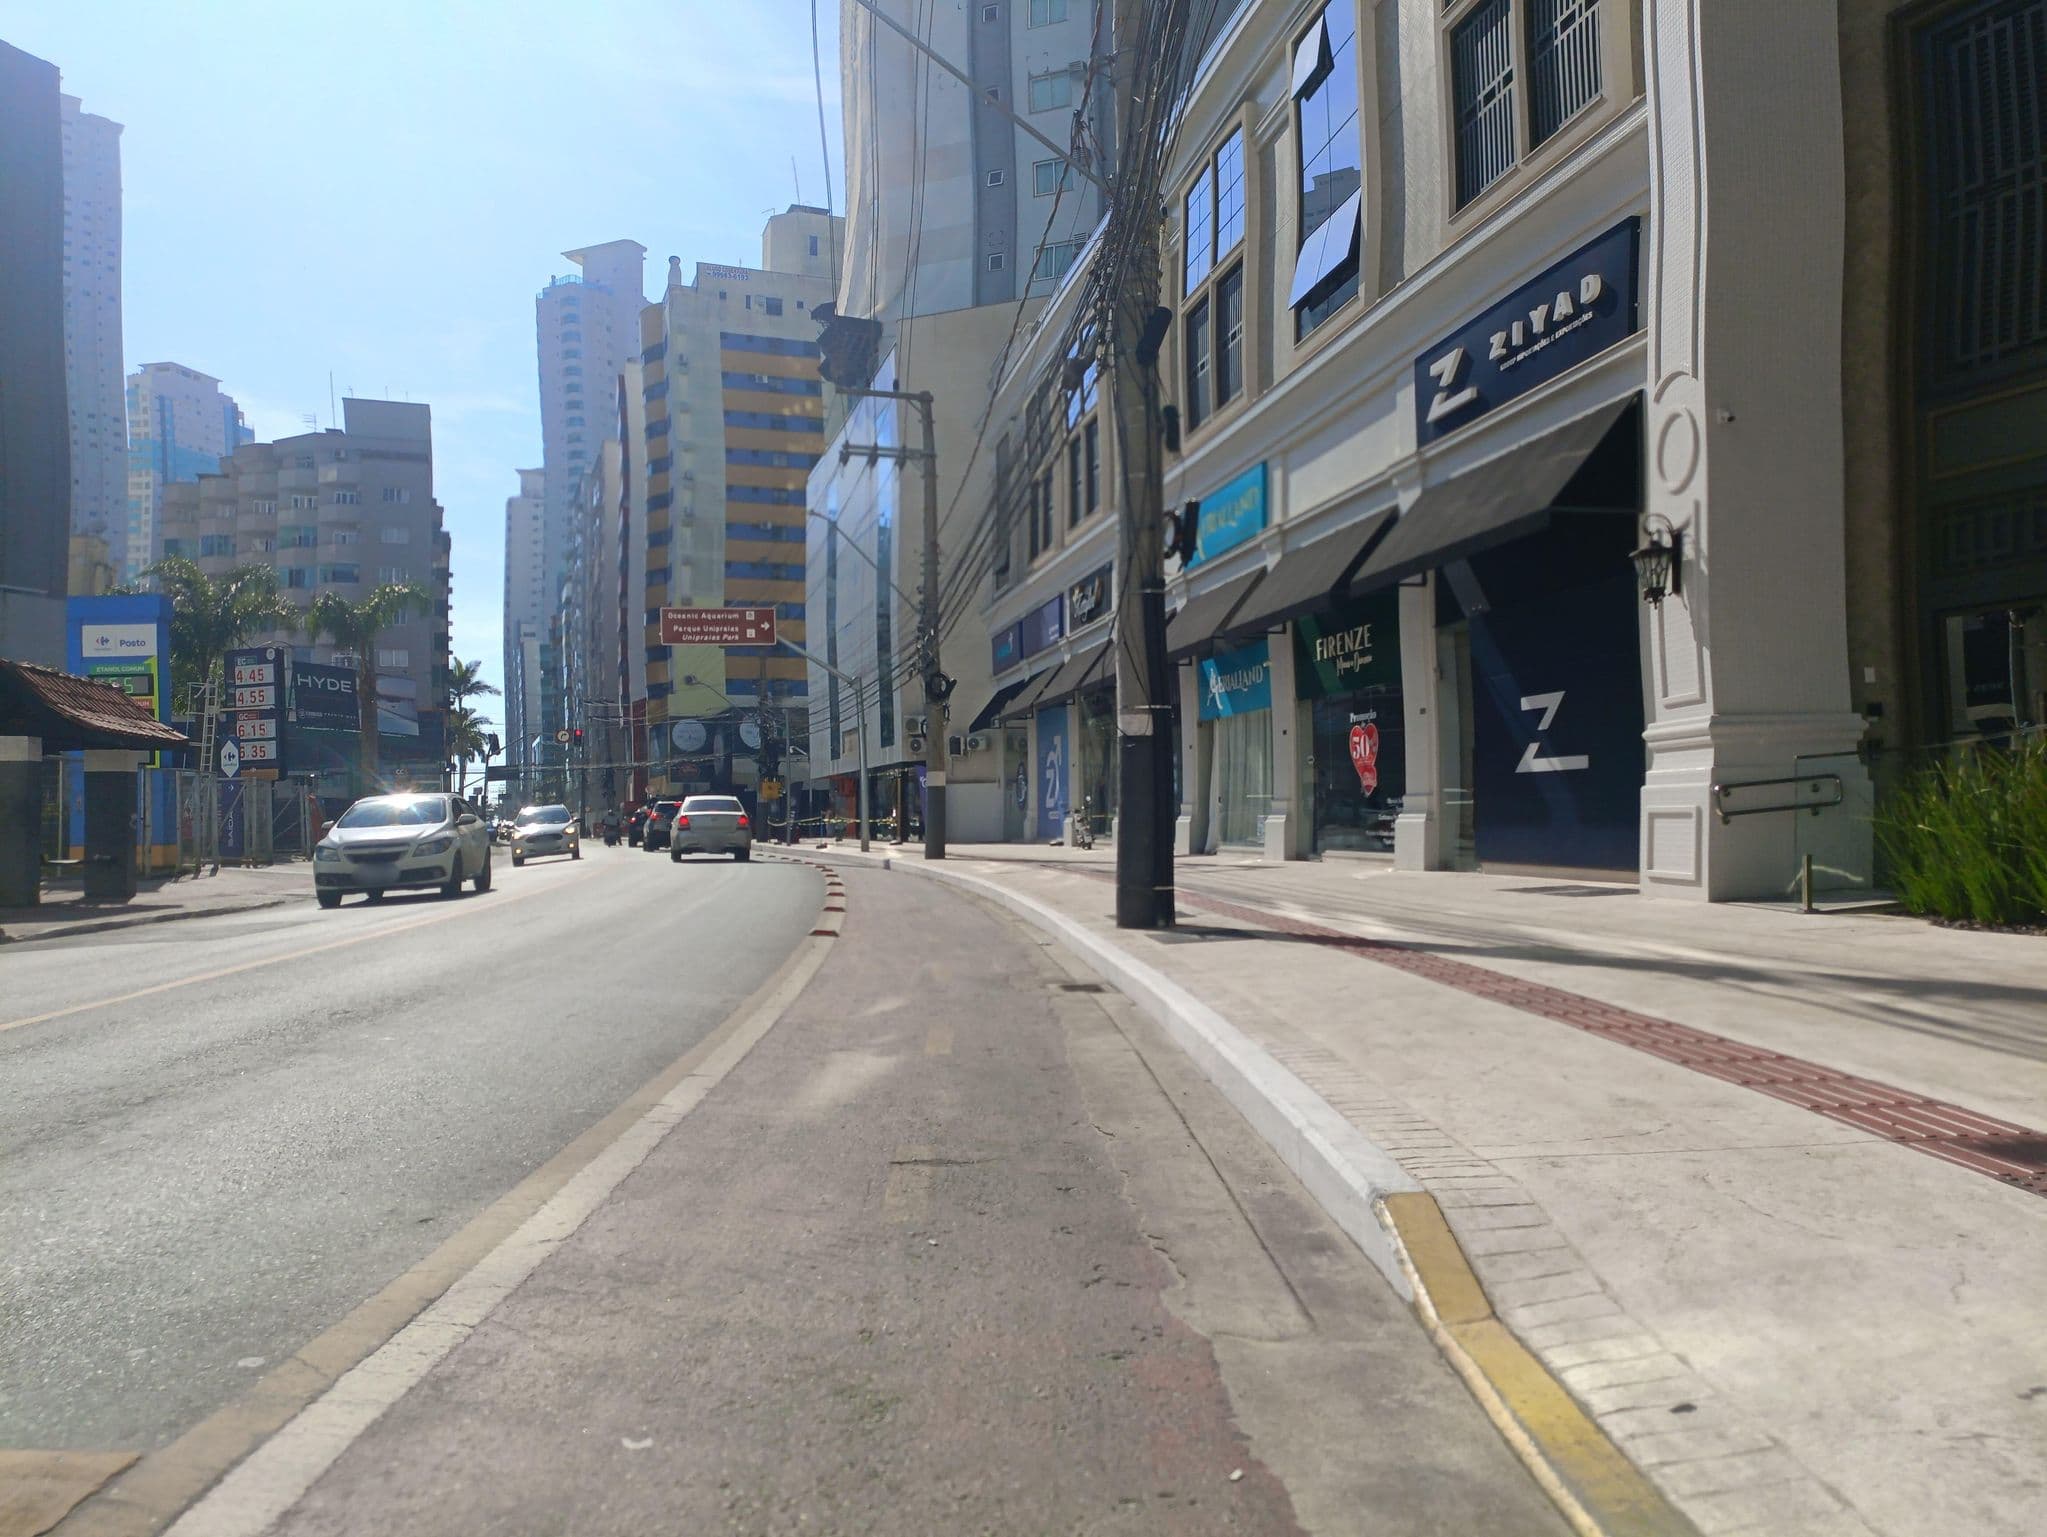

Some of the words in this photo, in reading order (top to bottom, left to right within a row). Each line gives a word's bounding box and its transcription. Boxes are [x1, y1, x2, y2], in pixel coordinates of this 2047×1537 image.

[1489, 274, 1602, 360] ZIYAD
[1426, 347, 1478, 422] Z
[673, 624, 700, 632] Parque
[701, 612, 739, 620] Aquarium
[120, 639, 146, 648] Posto
[1316, 624, 1373, 661] FIRENZE
[297, 673, 353, 693] HYDE
[1515, 691, 1589, 773] Z
